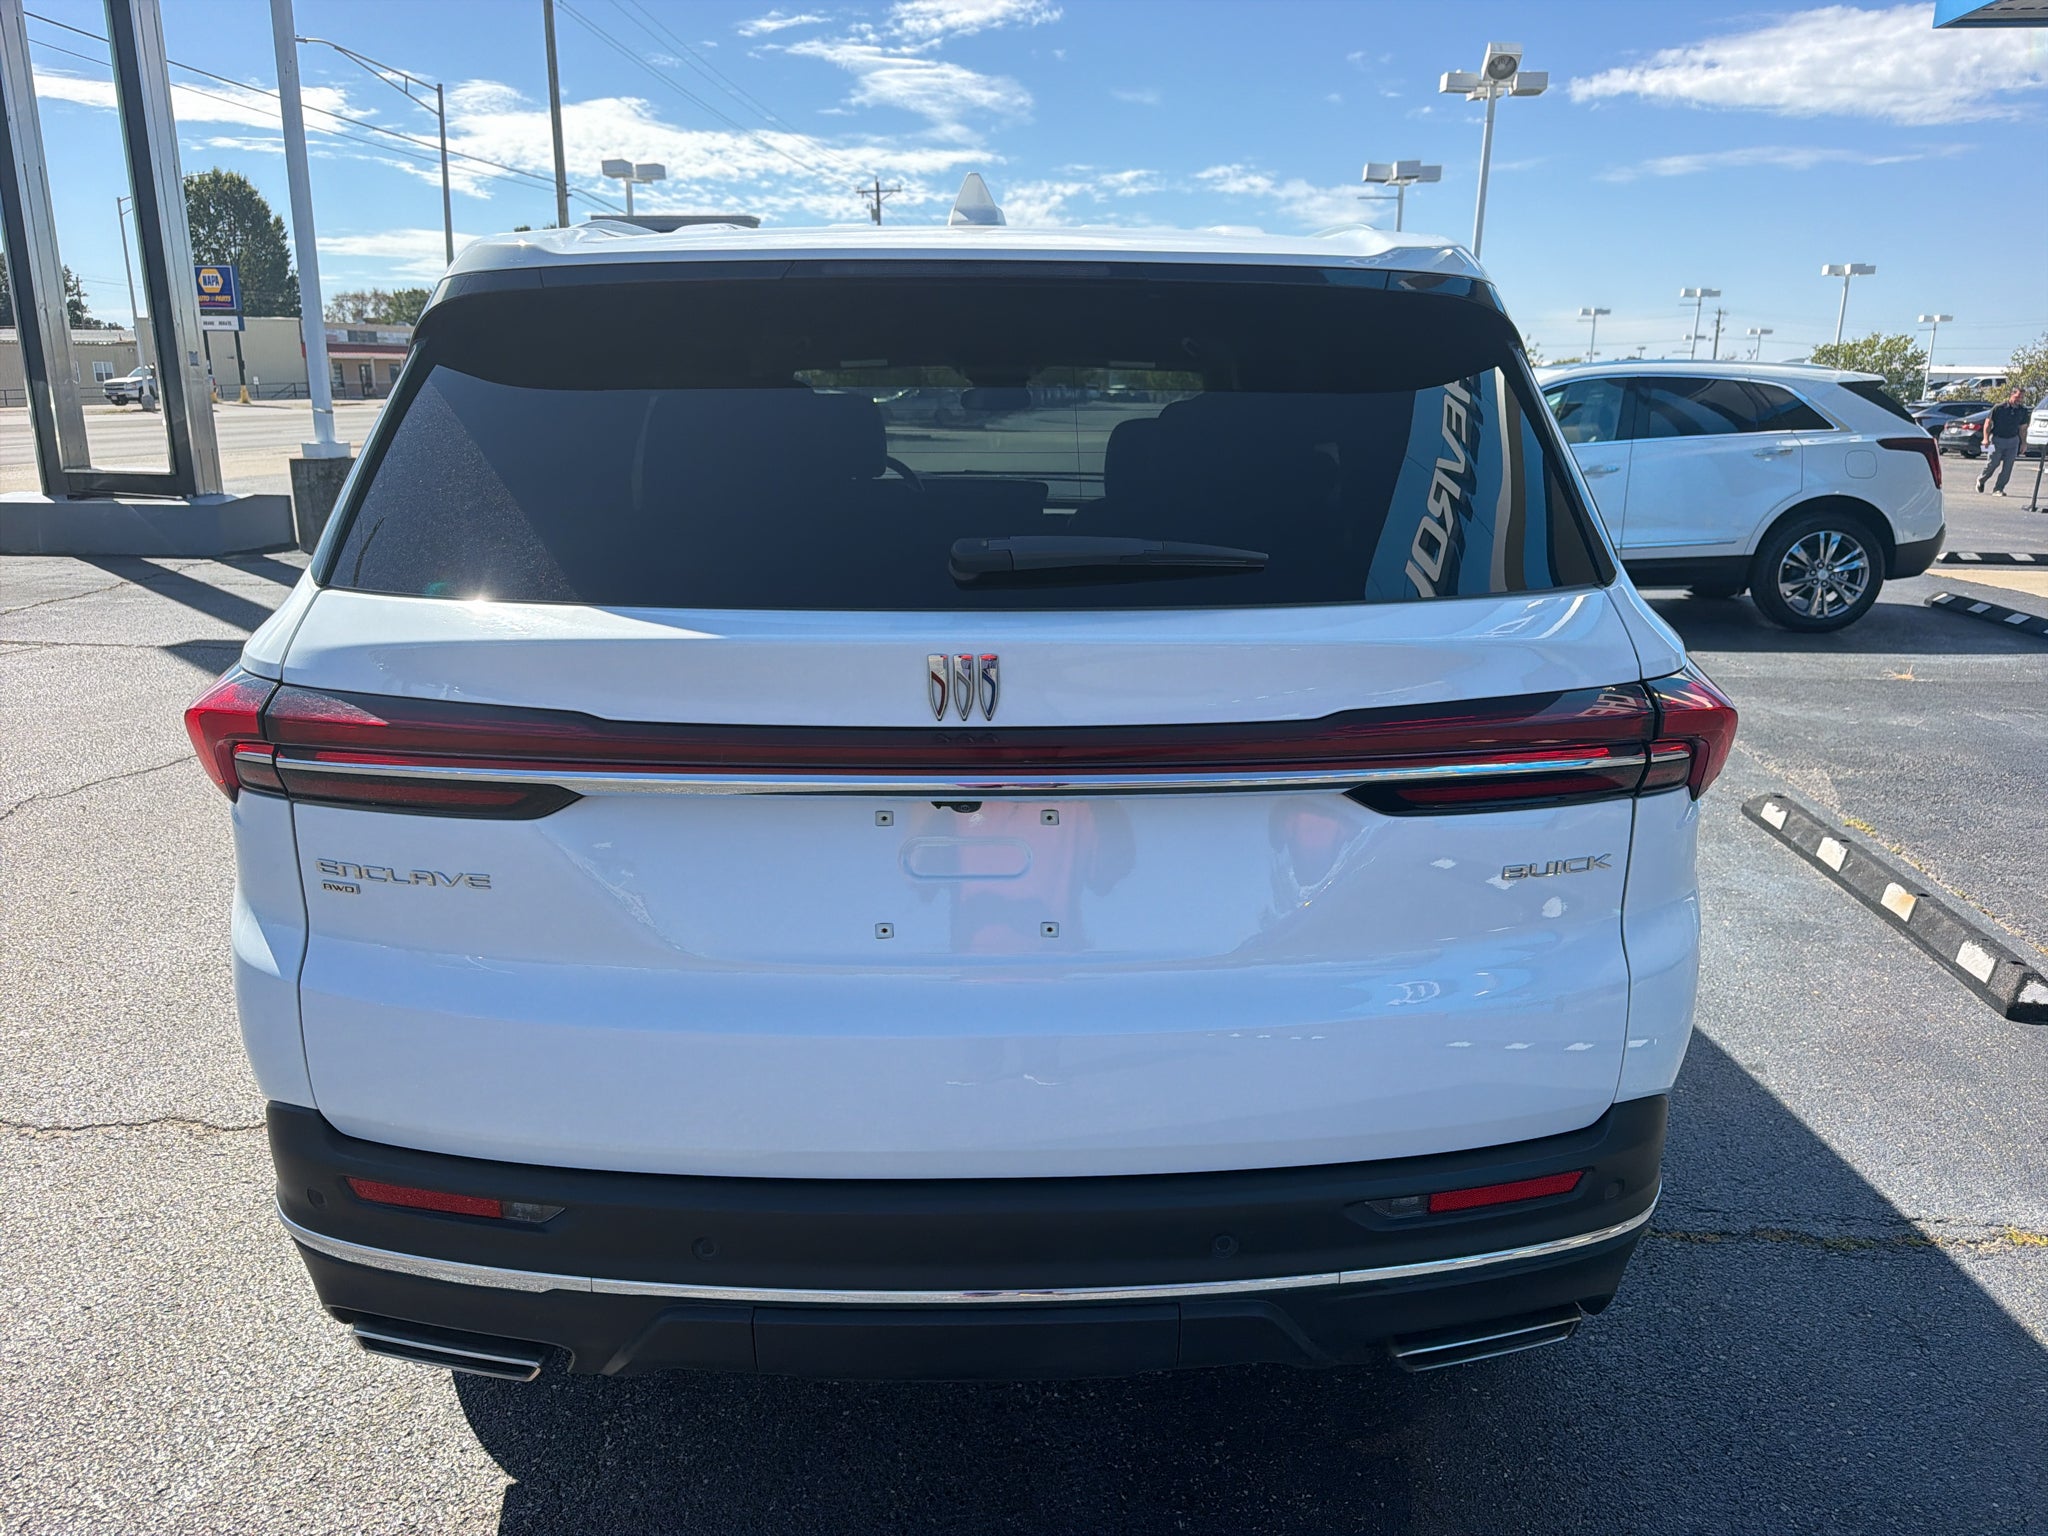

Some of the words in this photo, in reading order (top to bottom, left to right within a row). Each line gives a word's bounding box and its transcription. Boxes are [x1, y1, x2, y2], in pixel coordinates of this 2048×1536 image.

[202, 275, 220, 286] NAPA
[315, 858, 491, 889] ENCLAVE
[1502, 853, 1611, 880] BUICK
[323, 881, 358, 894] AWD
